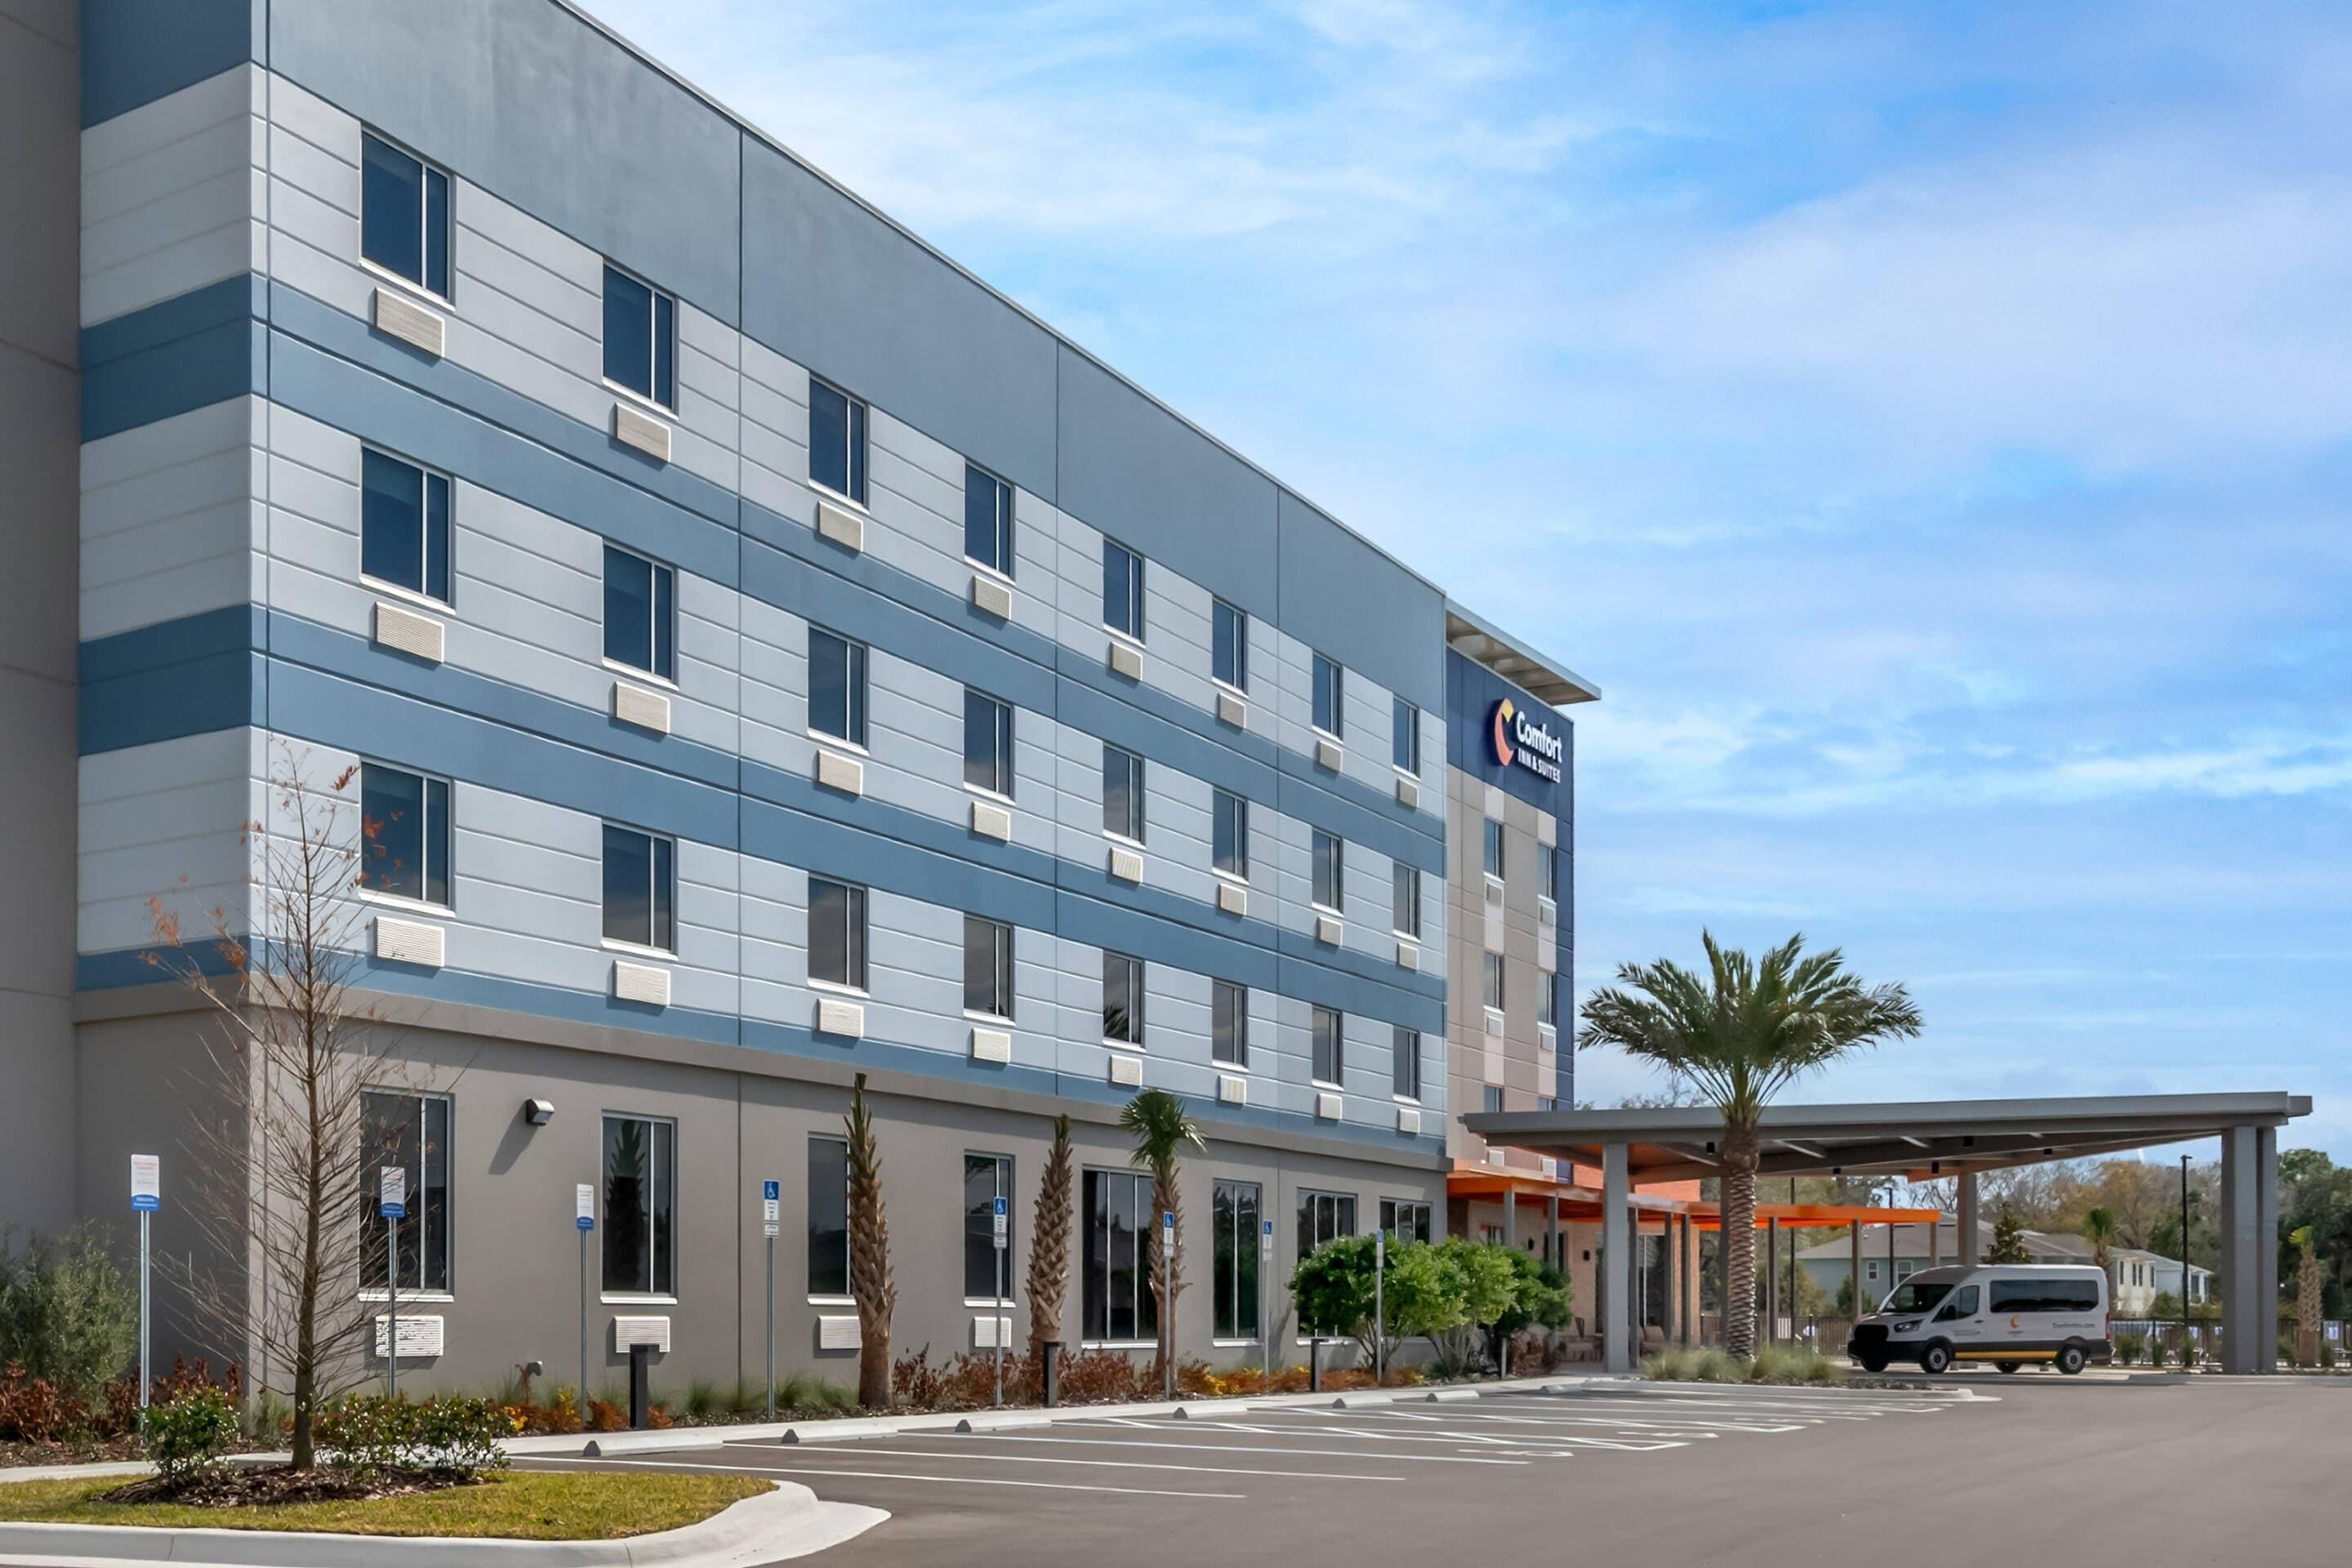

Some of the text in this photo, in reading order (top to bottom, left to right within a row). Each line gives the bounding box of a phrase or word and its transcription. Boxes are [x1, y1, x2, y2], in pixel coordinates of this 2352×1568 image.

[1517, 710, 1562, 763] Comfort
[1518, 747, 1561, 783] INN & SUITES
